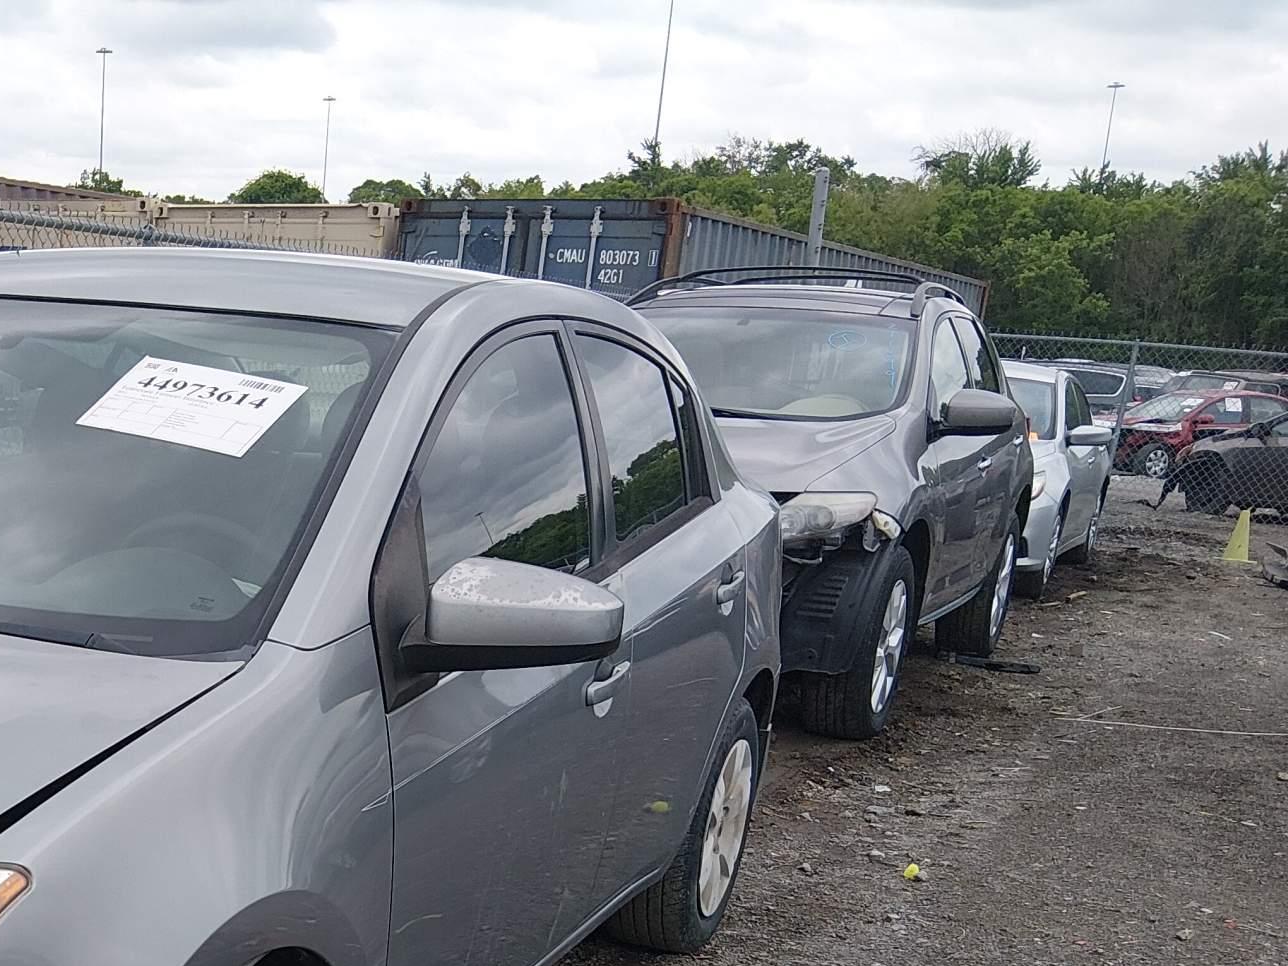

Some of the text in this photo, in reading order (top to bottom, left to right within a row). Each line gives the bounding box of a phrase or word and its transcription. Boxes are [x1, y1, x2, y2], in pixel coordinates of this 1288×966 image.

[556, 249, 586, 263] CMAU
[599, 249, 640, 266] 803073
[597, 268, 623, 284] 42G1
[137, 375, 269, 410] 44973614
